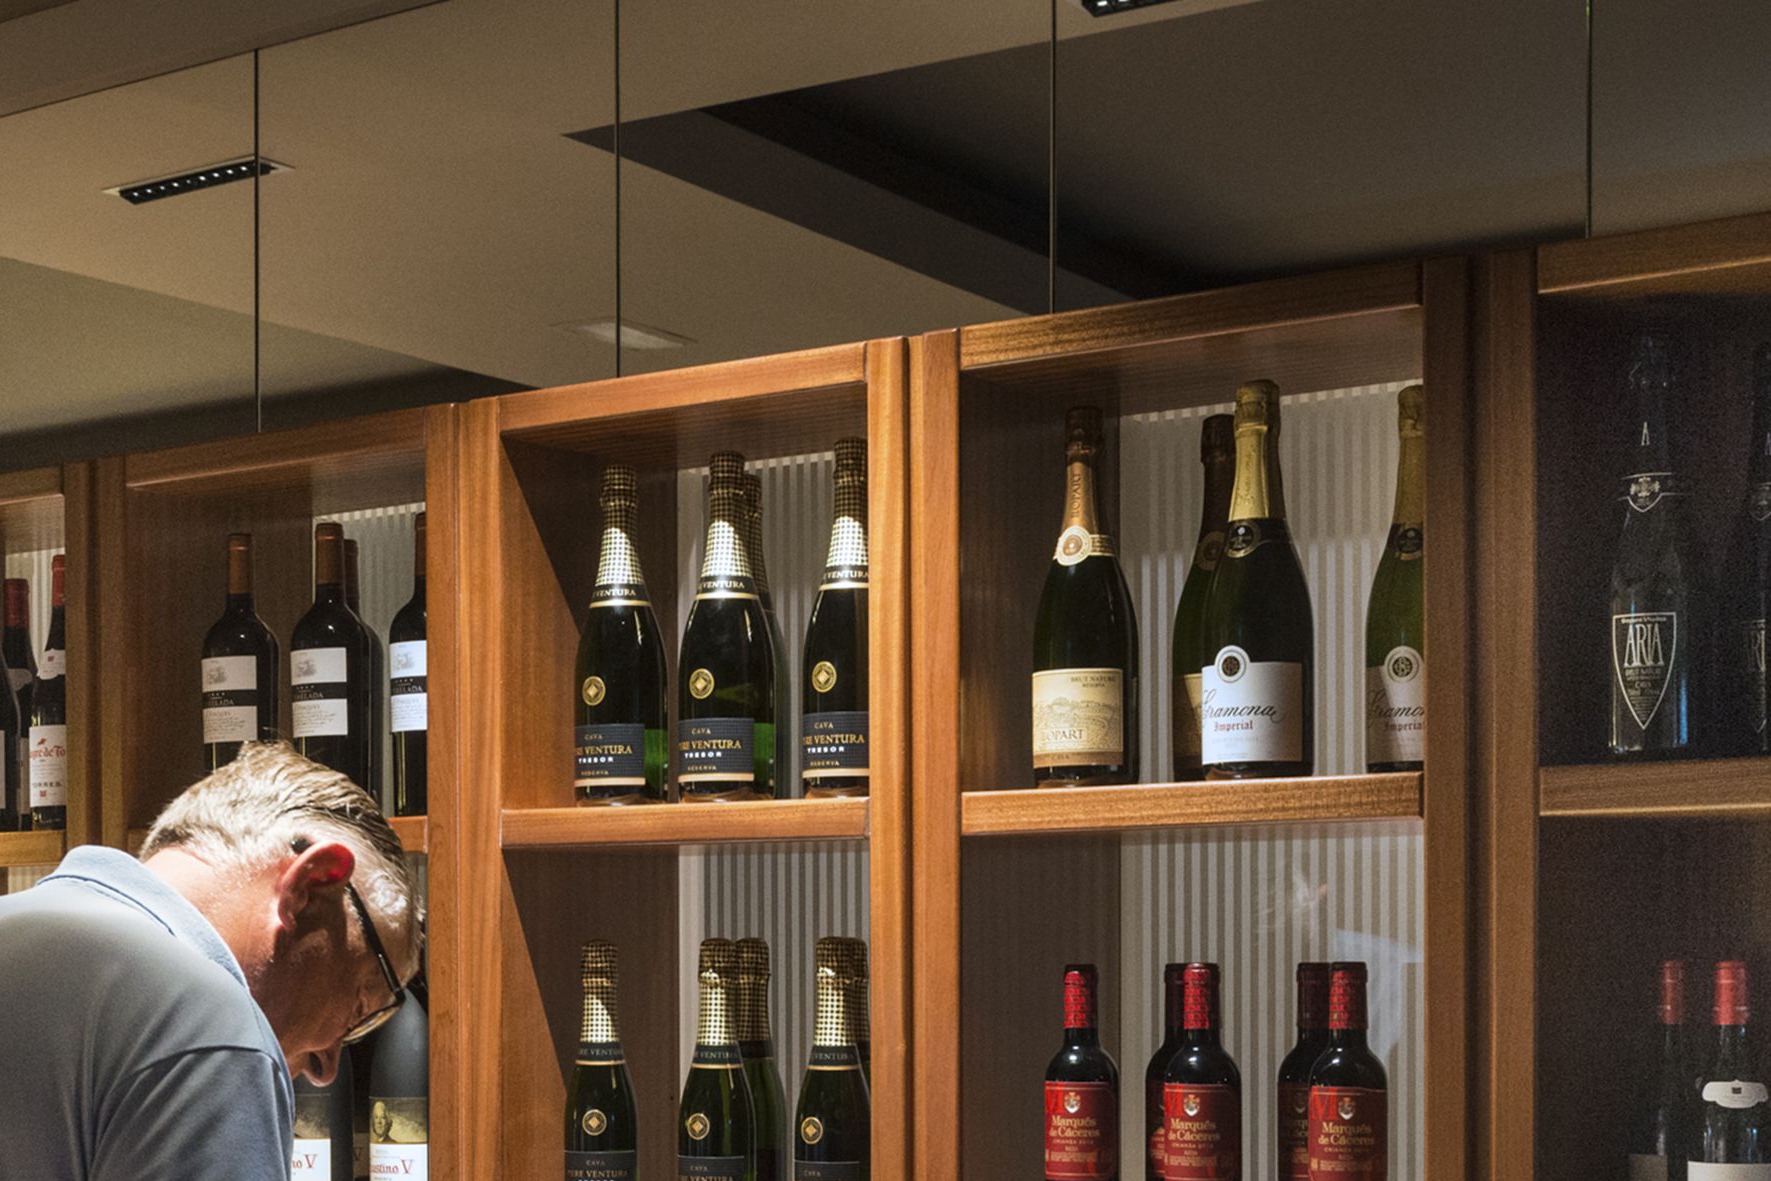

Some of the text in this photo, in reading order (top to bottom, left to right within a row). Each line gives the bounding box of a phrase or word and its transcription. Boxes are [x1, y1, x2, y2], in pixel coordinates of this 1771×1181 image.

[1624, 623, 1664, 667] ARIA
[691, 727, 712, 735] CAVA
[814, 721, 834, 729] CAVA
[1214, 720, 1253, 732] Imperial
[814, 733, 865, 745] VENTURA
[1047, 729, 1083, 741] OPART
[585, 745, 633, 755] VENTURA
[691, 739, 741, 750] VENTURA
[1051, 1114, 1097, 1128] Marqués
[1171, 1117, 1217, 1131] Marqués
[1049, 1126, 1101, 1137] de Cáceres
[1322, 1121, 1372, 1135] Marqués
[1176, 1129, 1220, 1141] Cáceres
[1318, 1133, 1374, 1146] de Cáceres
[304, 1153, 318, 1169] V
[400, 1159, 413, 1174] V
[586, 1169, 628, 1178] VENTURA
